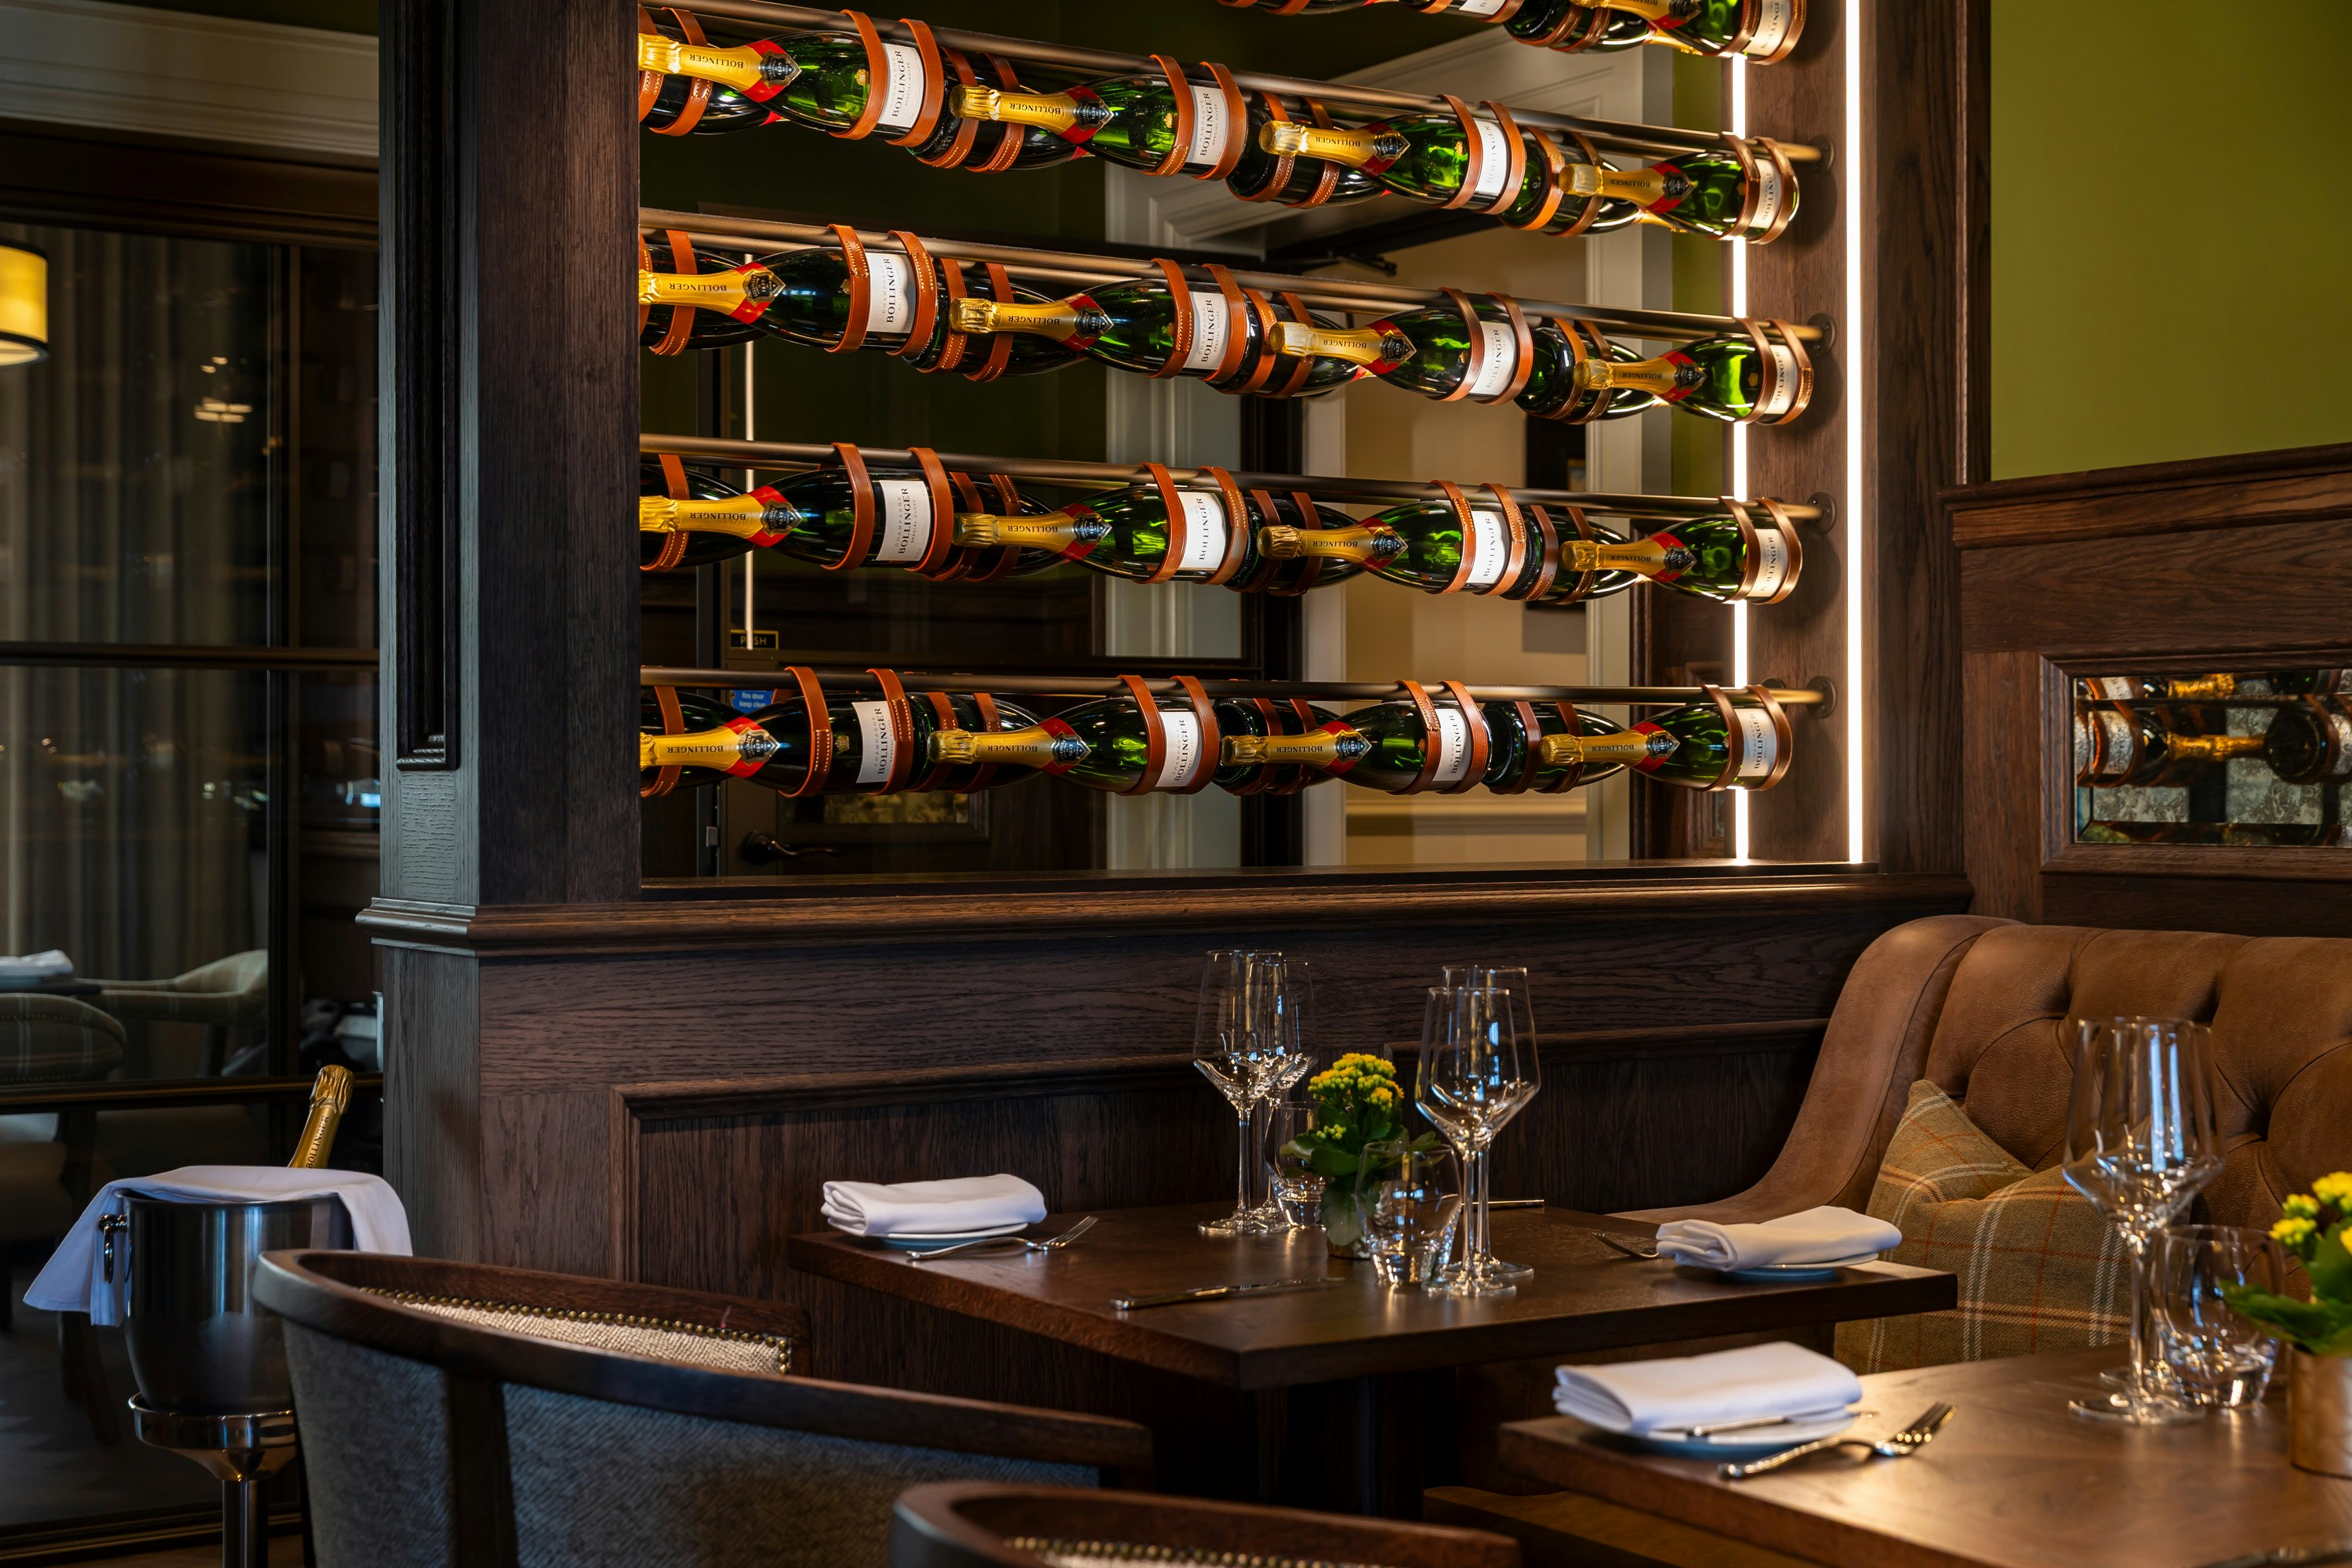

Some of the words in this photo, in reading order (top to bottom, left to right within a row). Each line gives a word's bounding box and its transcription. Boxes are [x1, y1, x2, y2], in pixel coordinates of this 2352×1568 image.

[689, 53, 744, 68] BOLLINGER
[892, 50, 906, 117] BOLLINGER
[1009, 103, 1061, 114] BOLLINGER
[1200, 93, 1213, 156] BOLLINGER
[1316, 136, 1361, 147] BOLLINGER
[1610, 179, 1650, 188] BOLLINGER
[669, 283, 727, 292] BOLLINGER
[884, 258, 896, 323] BOLLINGER
[1008, 315, 1060, 325] BOLLINGER
[1201, 299, 1214, 362] BOLLINGER
[1323, 339, 1367, 349] BOLLINGER
[1486, 328, 1502, 388] BOLLINGER
[690, 512, 746, 521] BOLLINGER
[895, 497, 903, 546] CHAMPAGNE
[898, 488, 911, 554] BOLLINGER
[1196, 498, 1209, 560] BOLLINGER
[1761, 537, 1777, 591] LLINGER
[740, 636, 767, 647] PSH
[871, 717, 880, 766] CHAMPAGNE
[874, 708, 887, 775] BOLLINGER
[1174, 720, 1188, 781] BOLLINGER
[1449, 715, 1461, 774] BOLLINGER
[1749, 713, 1763, 769] BOLLINGER
[306, 1116, 329, 1168] BOLLINGER
